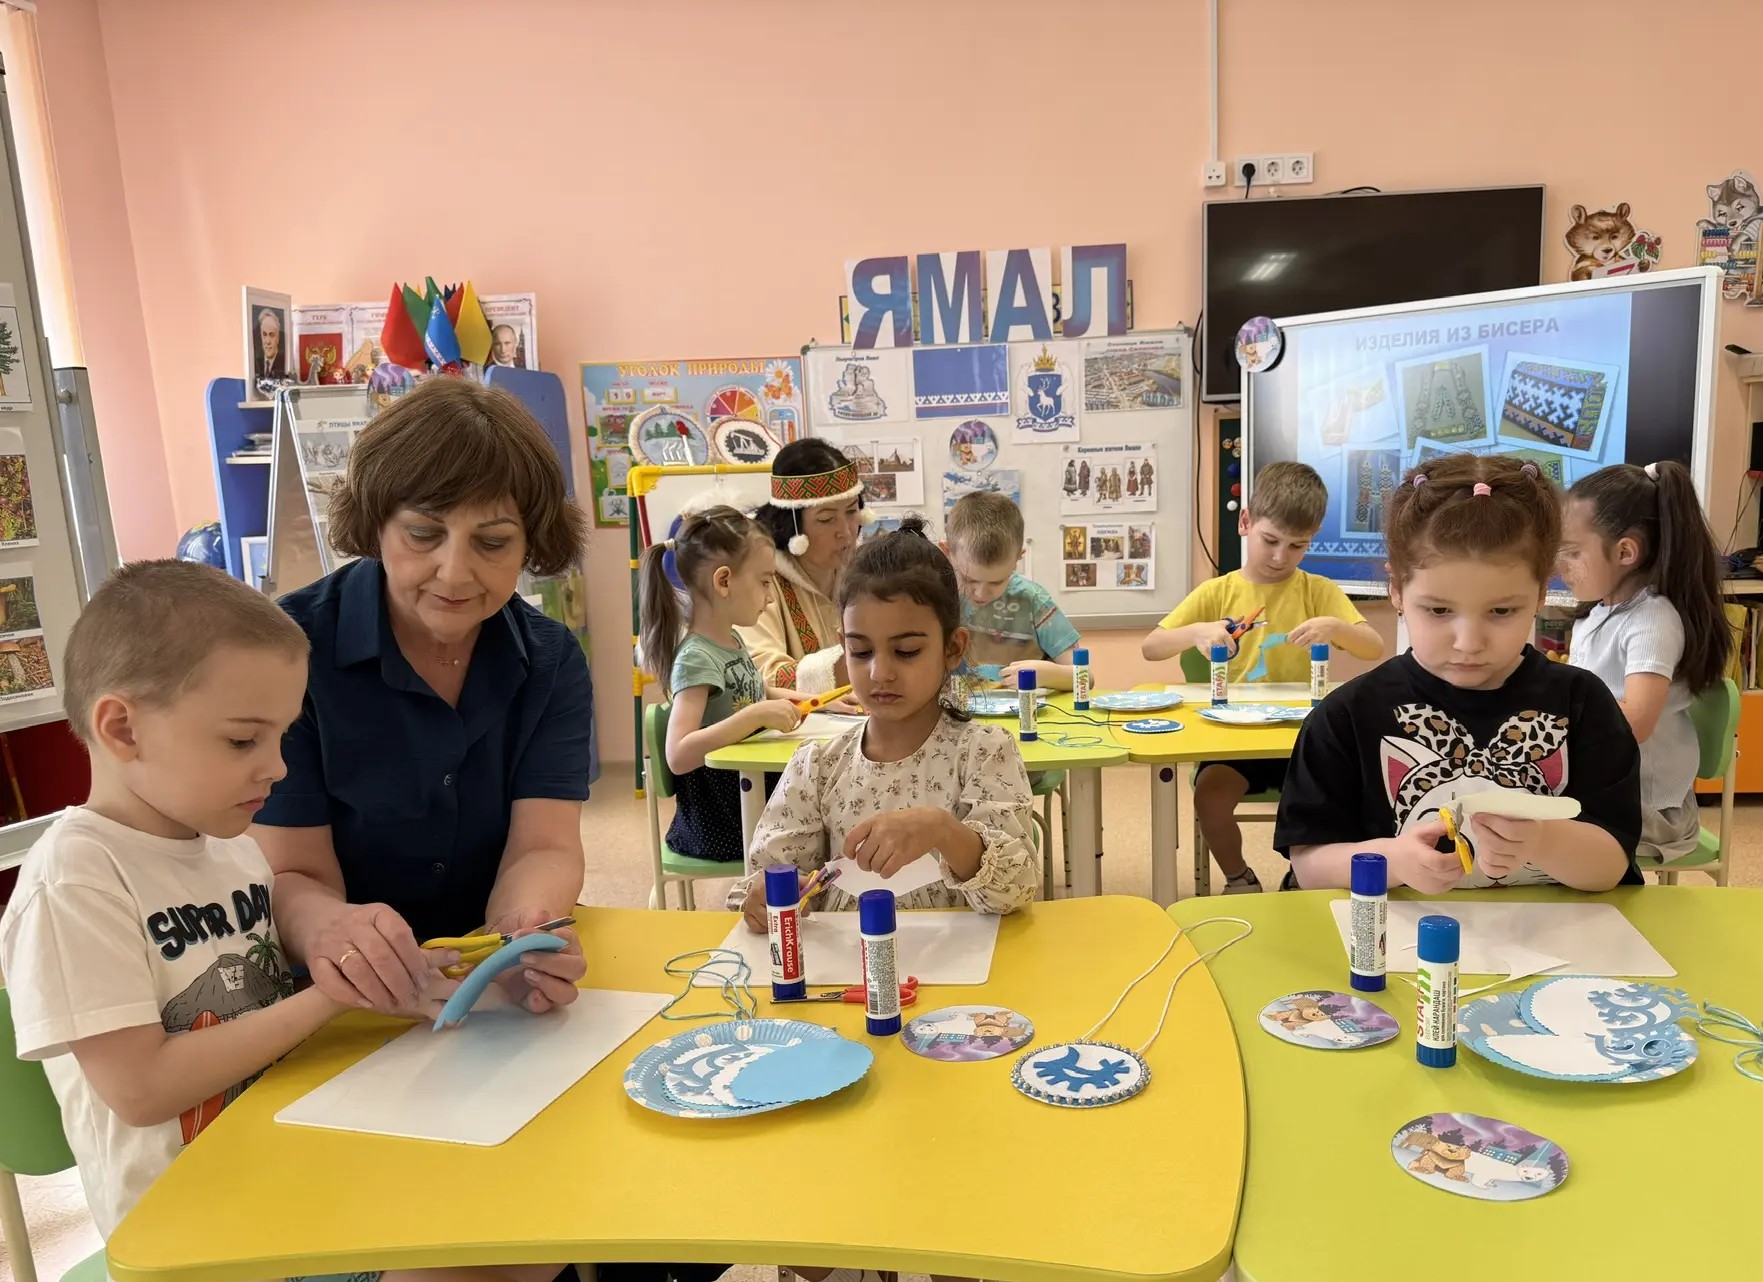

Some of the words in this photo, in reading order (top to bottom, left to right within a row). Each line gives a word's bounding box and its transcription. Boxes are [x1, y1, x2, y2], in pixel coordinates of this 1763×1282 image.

[852, 243, 1127, 350] ЯМАЛ
[1356, 329, 1440, 351] ИЗДЕЛИЯ
[1446, 325, 1472, 343] ИЗ
[1478, 317, 1560, 339] БИСЕРА
[617, 363, 680, 378] УГОЛОК
[688, 360, 765, 376] ПРИРОДЫ
[783, 916, 794, 973] ErichKrause
